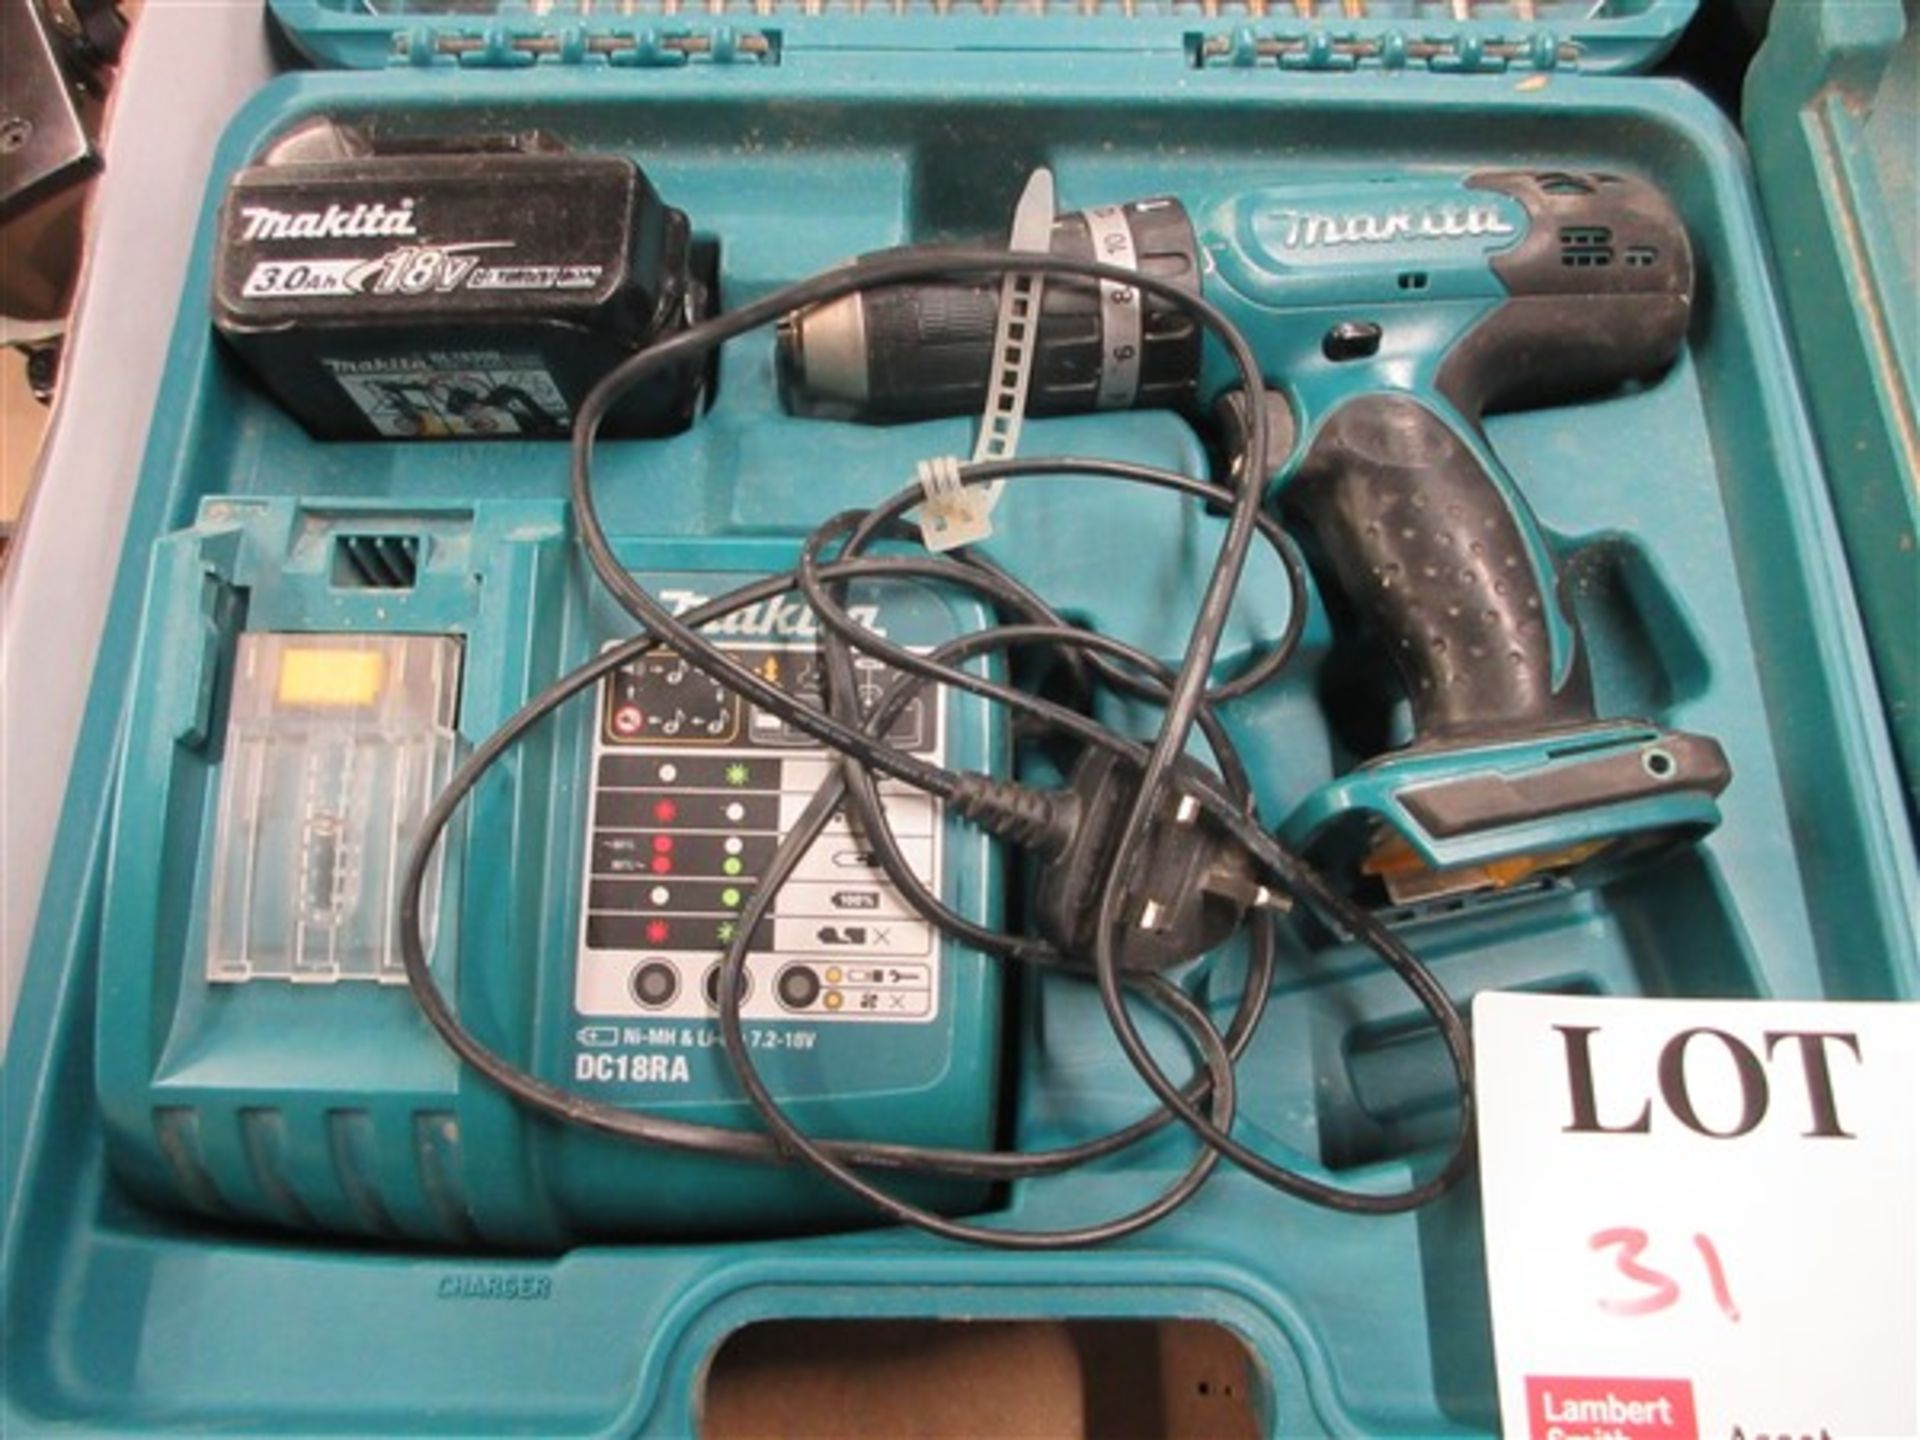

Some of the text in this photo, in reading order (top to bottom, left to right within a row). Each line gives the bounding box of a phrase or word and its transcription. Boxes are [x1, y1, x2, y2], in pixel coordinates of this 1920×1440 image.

[253, 265, 338, 291] 3.0Ah
[624, 1028, 676, 1046] Ni-MH
[679, 1029, 694, 1047] &
[575, 1055, 690, 1083] DC18RA
[1551, 1023, 1862, 1140] LOT
[1588, 1226, 1741, 1323] 31
[1543, 1391, 1673, 1427] Lambert
